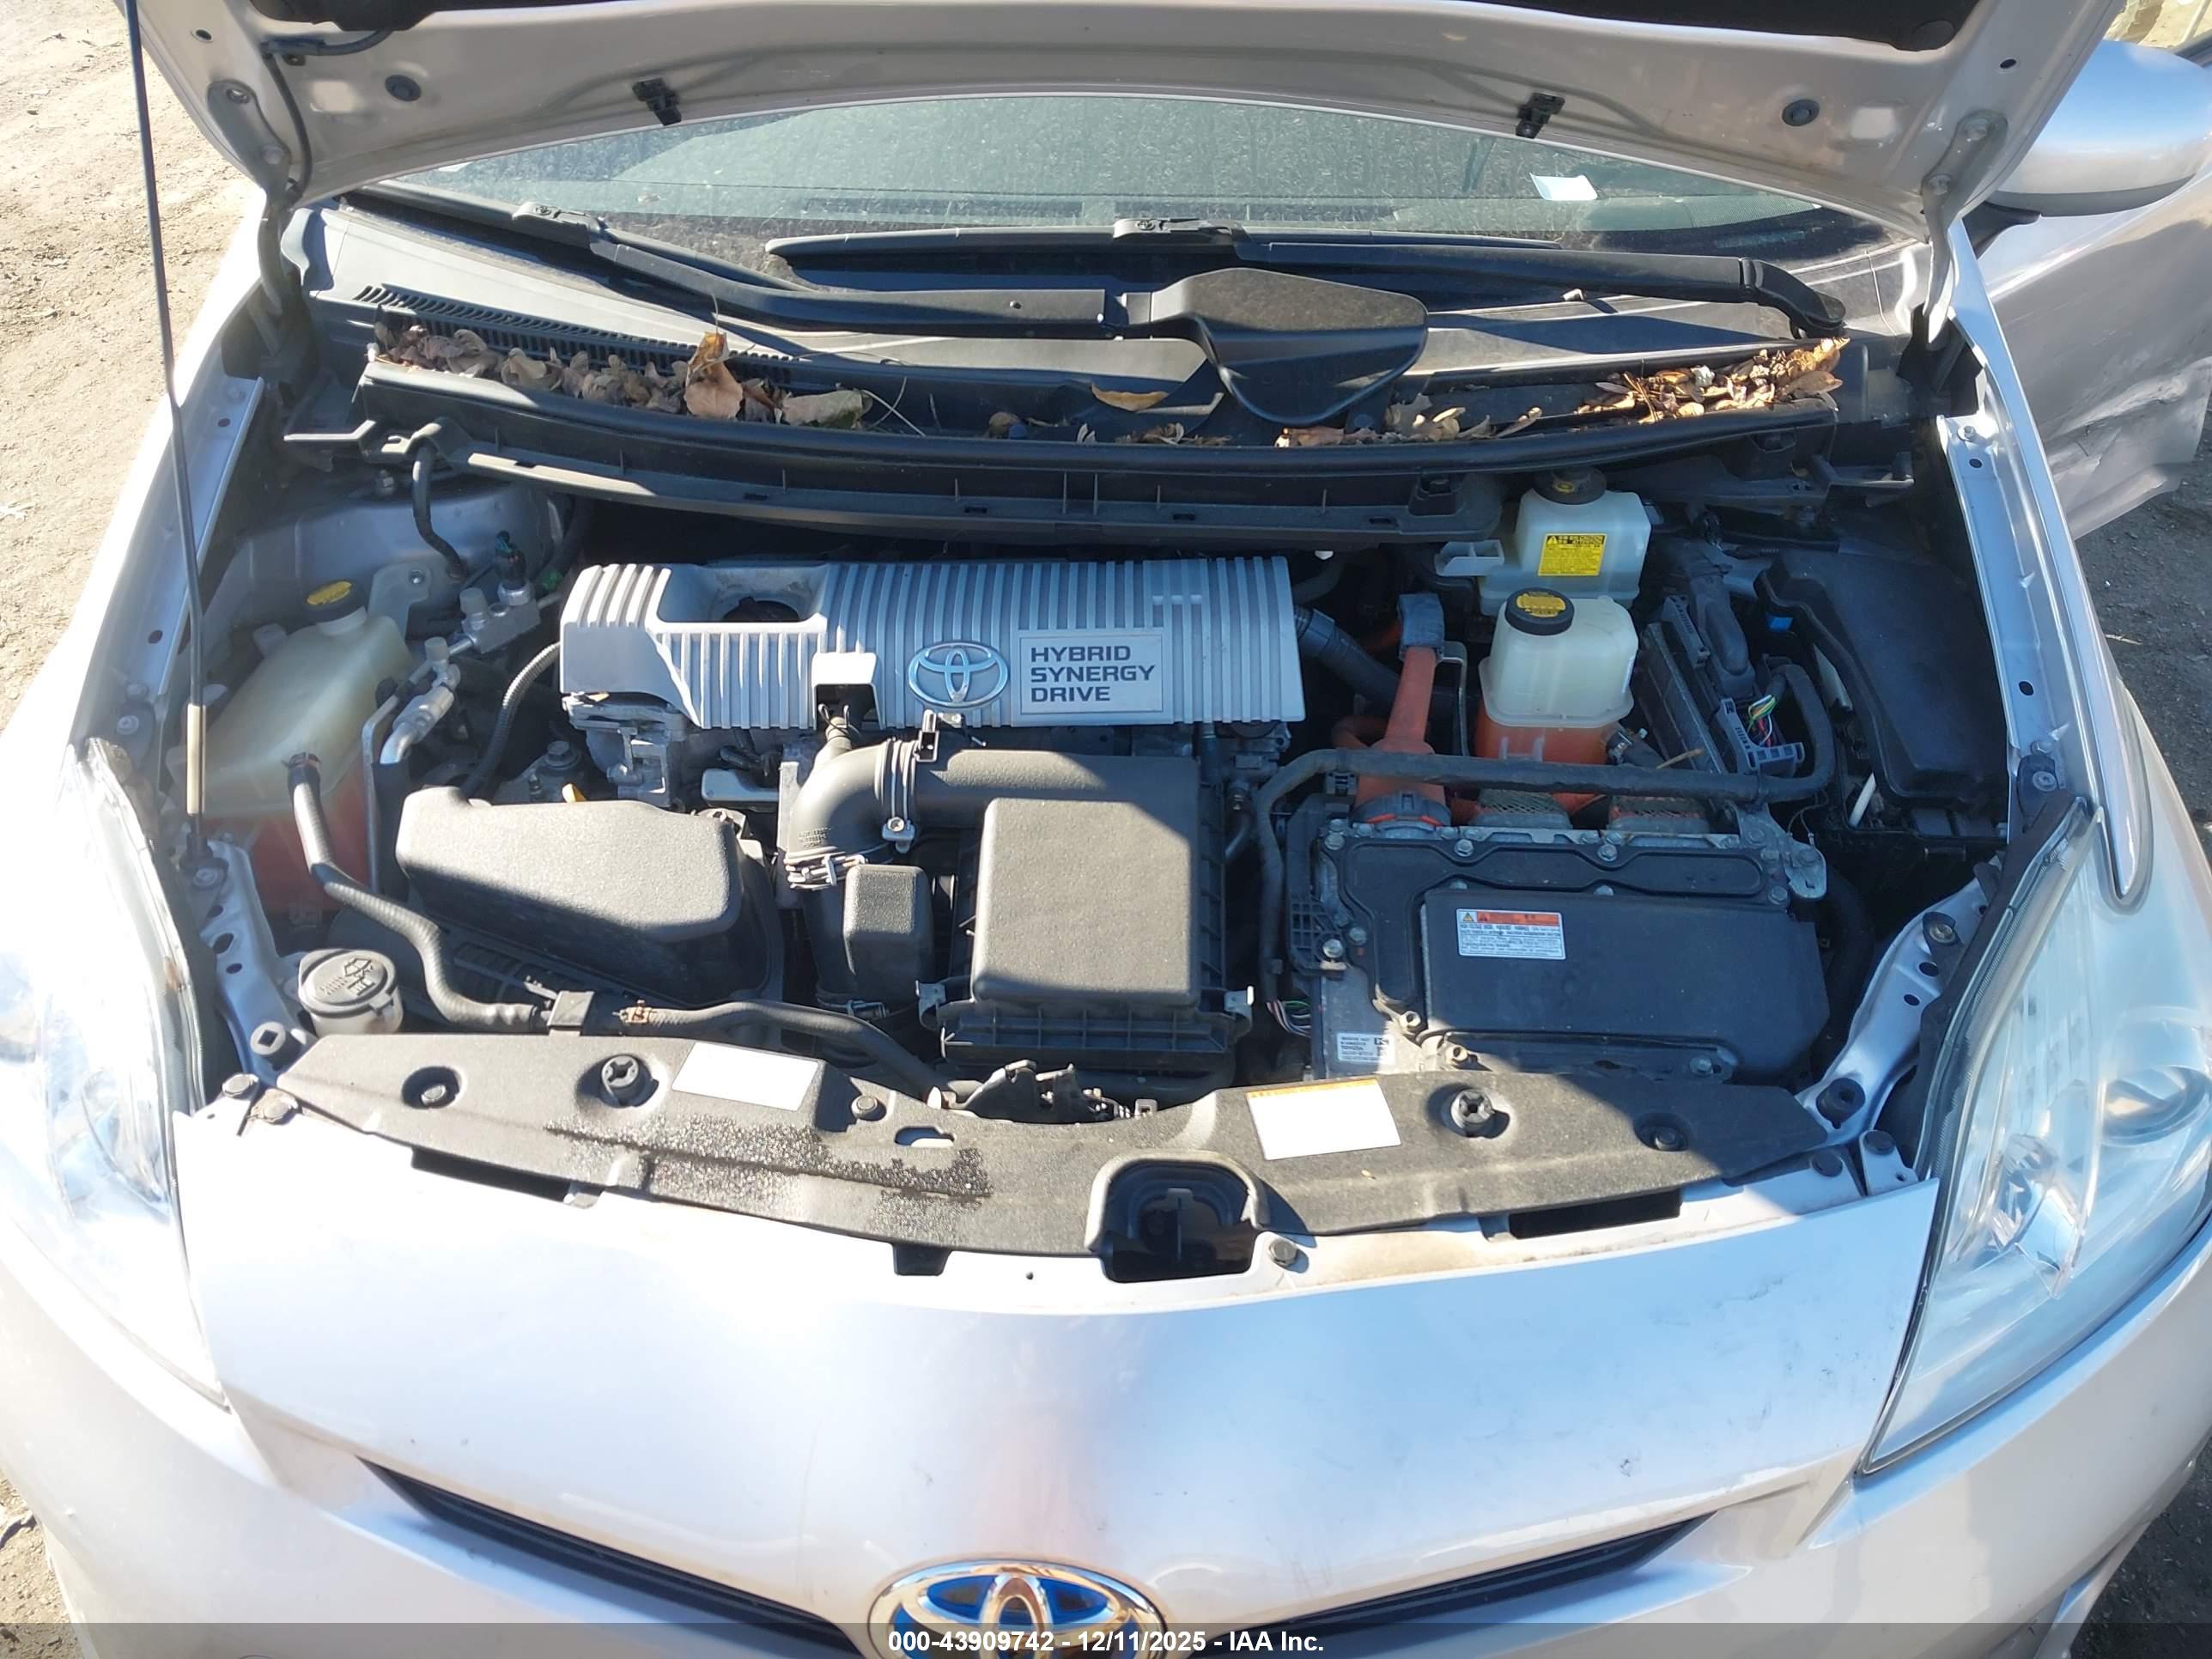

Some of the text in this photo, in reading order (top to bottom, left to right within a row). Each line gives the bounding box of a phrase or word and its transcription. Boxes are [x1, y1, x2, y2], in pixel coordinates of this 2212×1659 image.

[1031, 646, 1131, 662] HYBRID
[1030, 665, 1156, 683] SYNERGY
[1031, 686, 1110, 702] DRIVE
